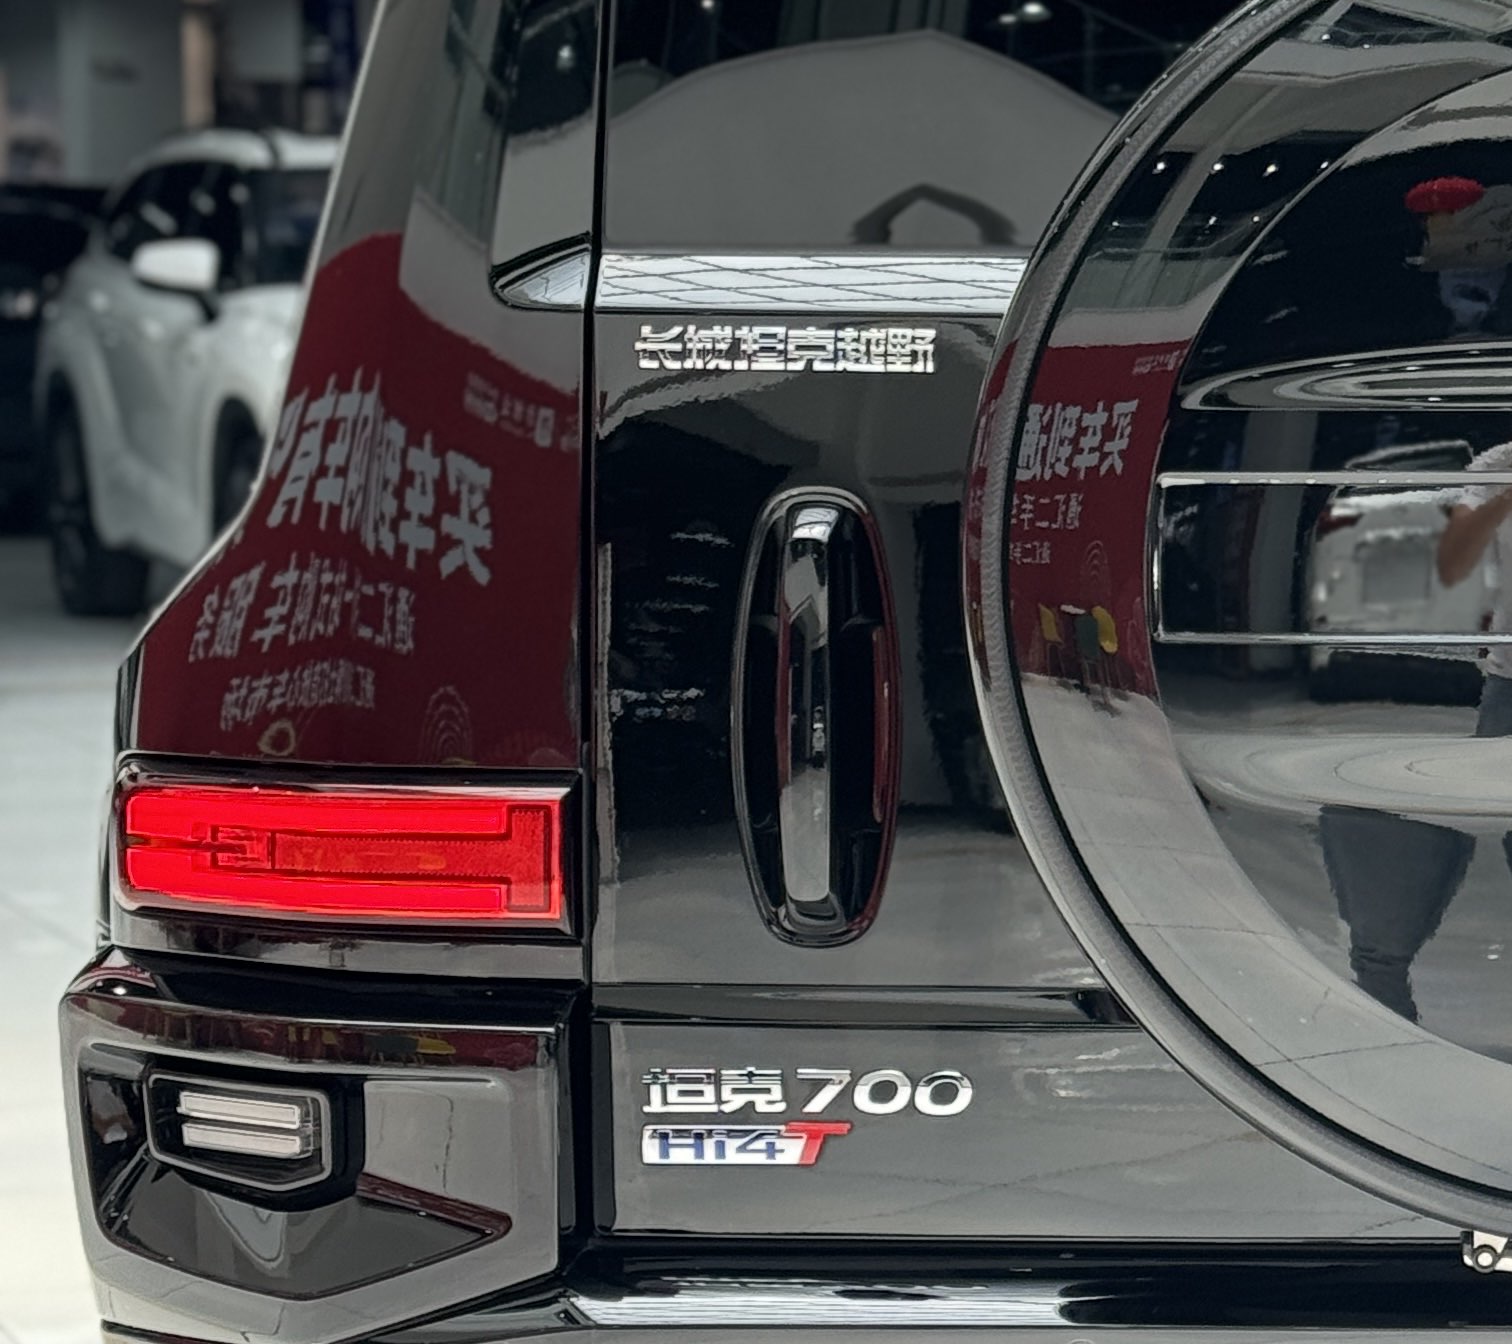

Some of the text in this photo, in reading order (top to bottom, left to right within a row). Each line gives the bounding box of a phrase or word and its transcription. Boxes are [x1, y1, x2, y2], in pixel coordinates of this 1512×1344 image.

[634, 324, 937, 374] 长城坦克越野
